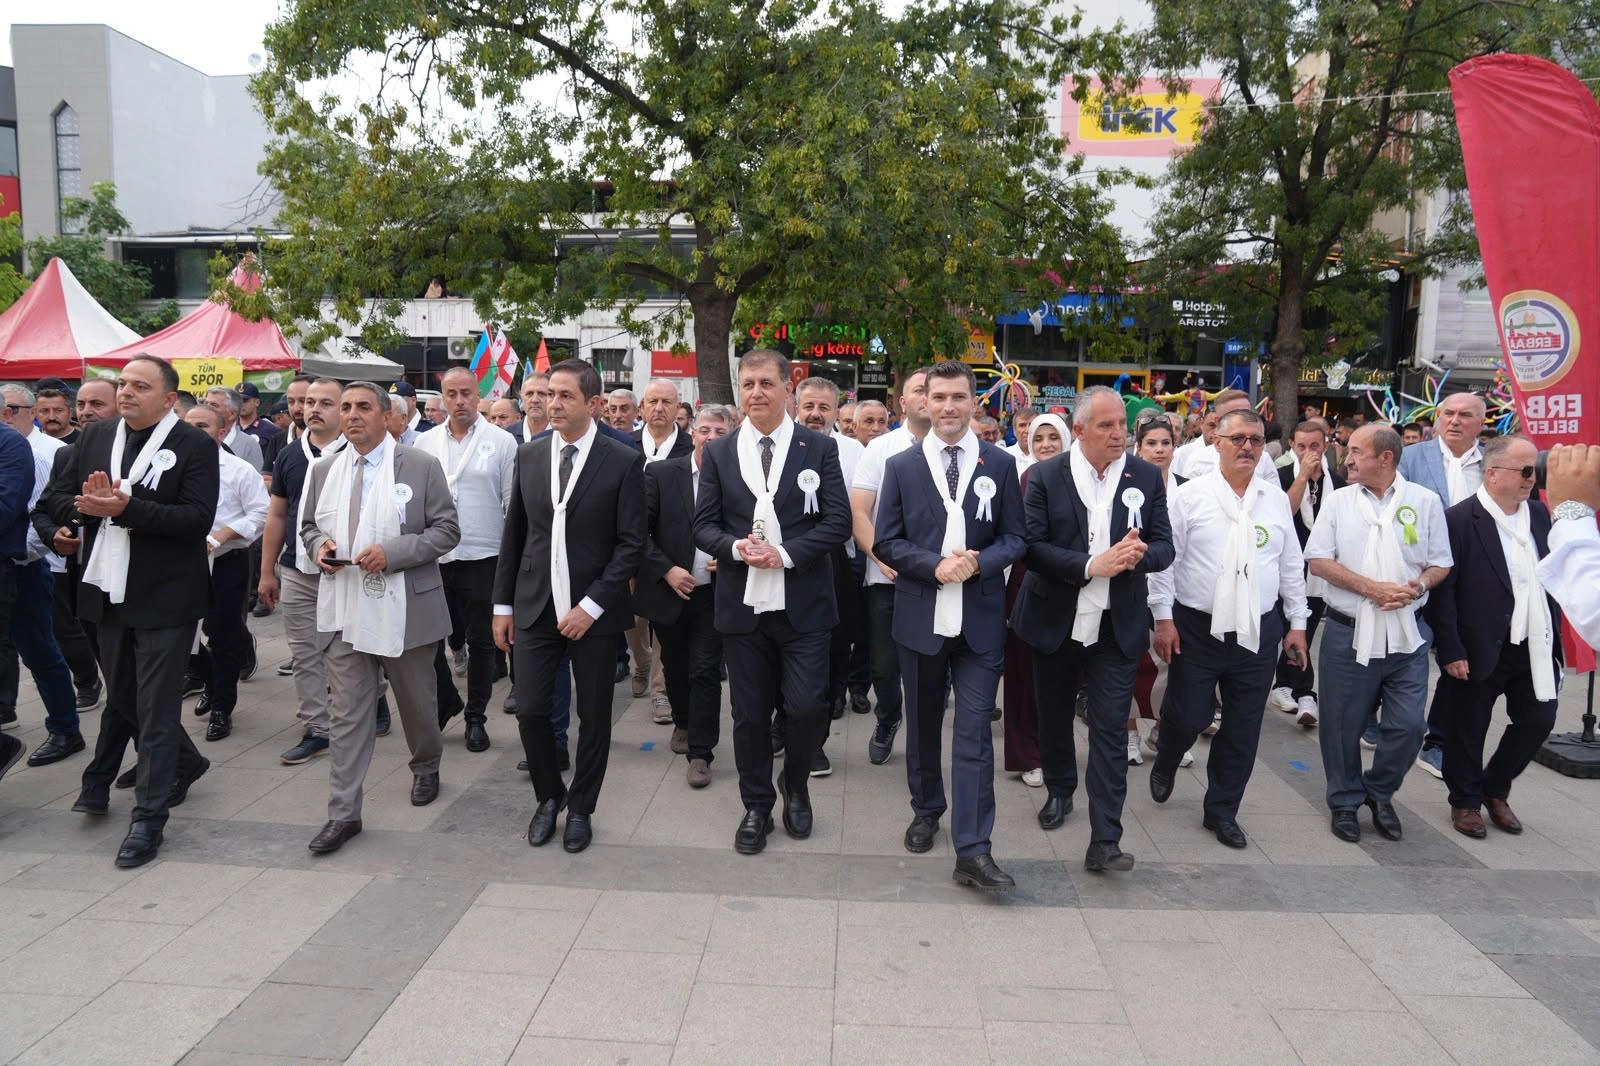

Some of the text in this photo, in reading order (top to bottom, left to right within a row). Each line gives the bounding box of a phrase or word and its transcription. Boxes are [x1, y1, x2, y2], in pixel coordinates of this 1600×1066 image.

[1186, 301, 1228, 313] Hotpoi
[198, 363, 216, 372] TÜM
[191, 374, 223, 386] SPOR
[1045, 385, 1076, 397] REGAL
